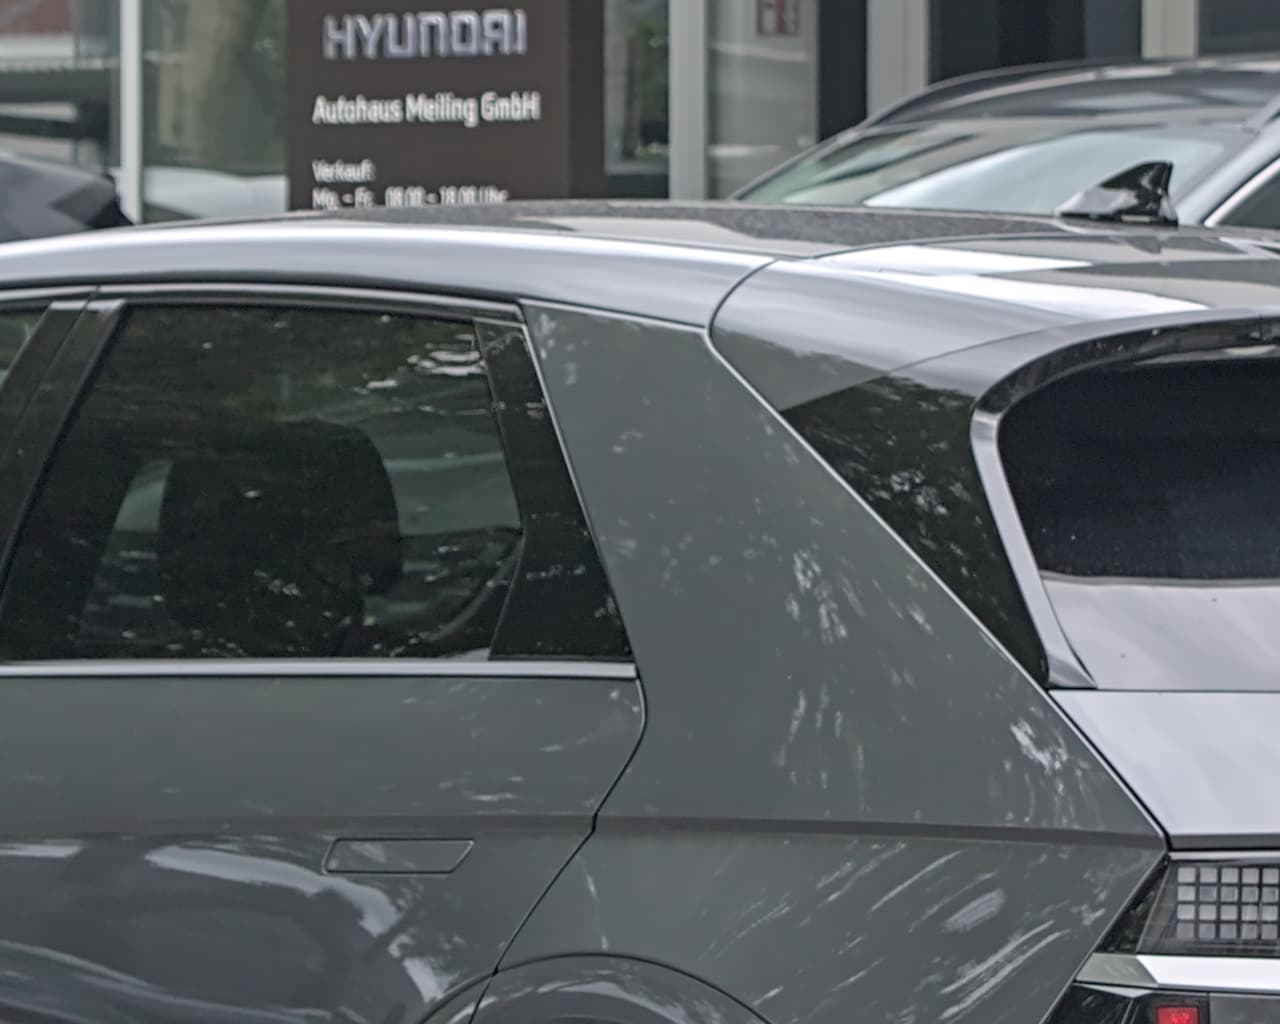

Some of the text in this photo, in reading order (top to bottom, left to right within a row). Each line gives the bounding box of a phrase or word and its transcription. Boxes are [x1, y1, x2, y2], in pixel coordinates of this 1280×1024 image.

[323, 8, 527, 60] HYUNDAI
[312, 91, 541, 127] Autohaus Meiling GmbH
